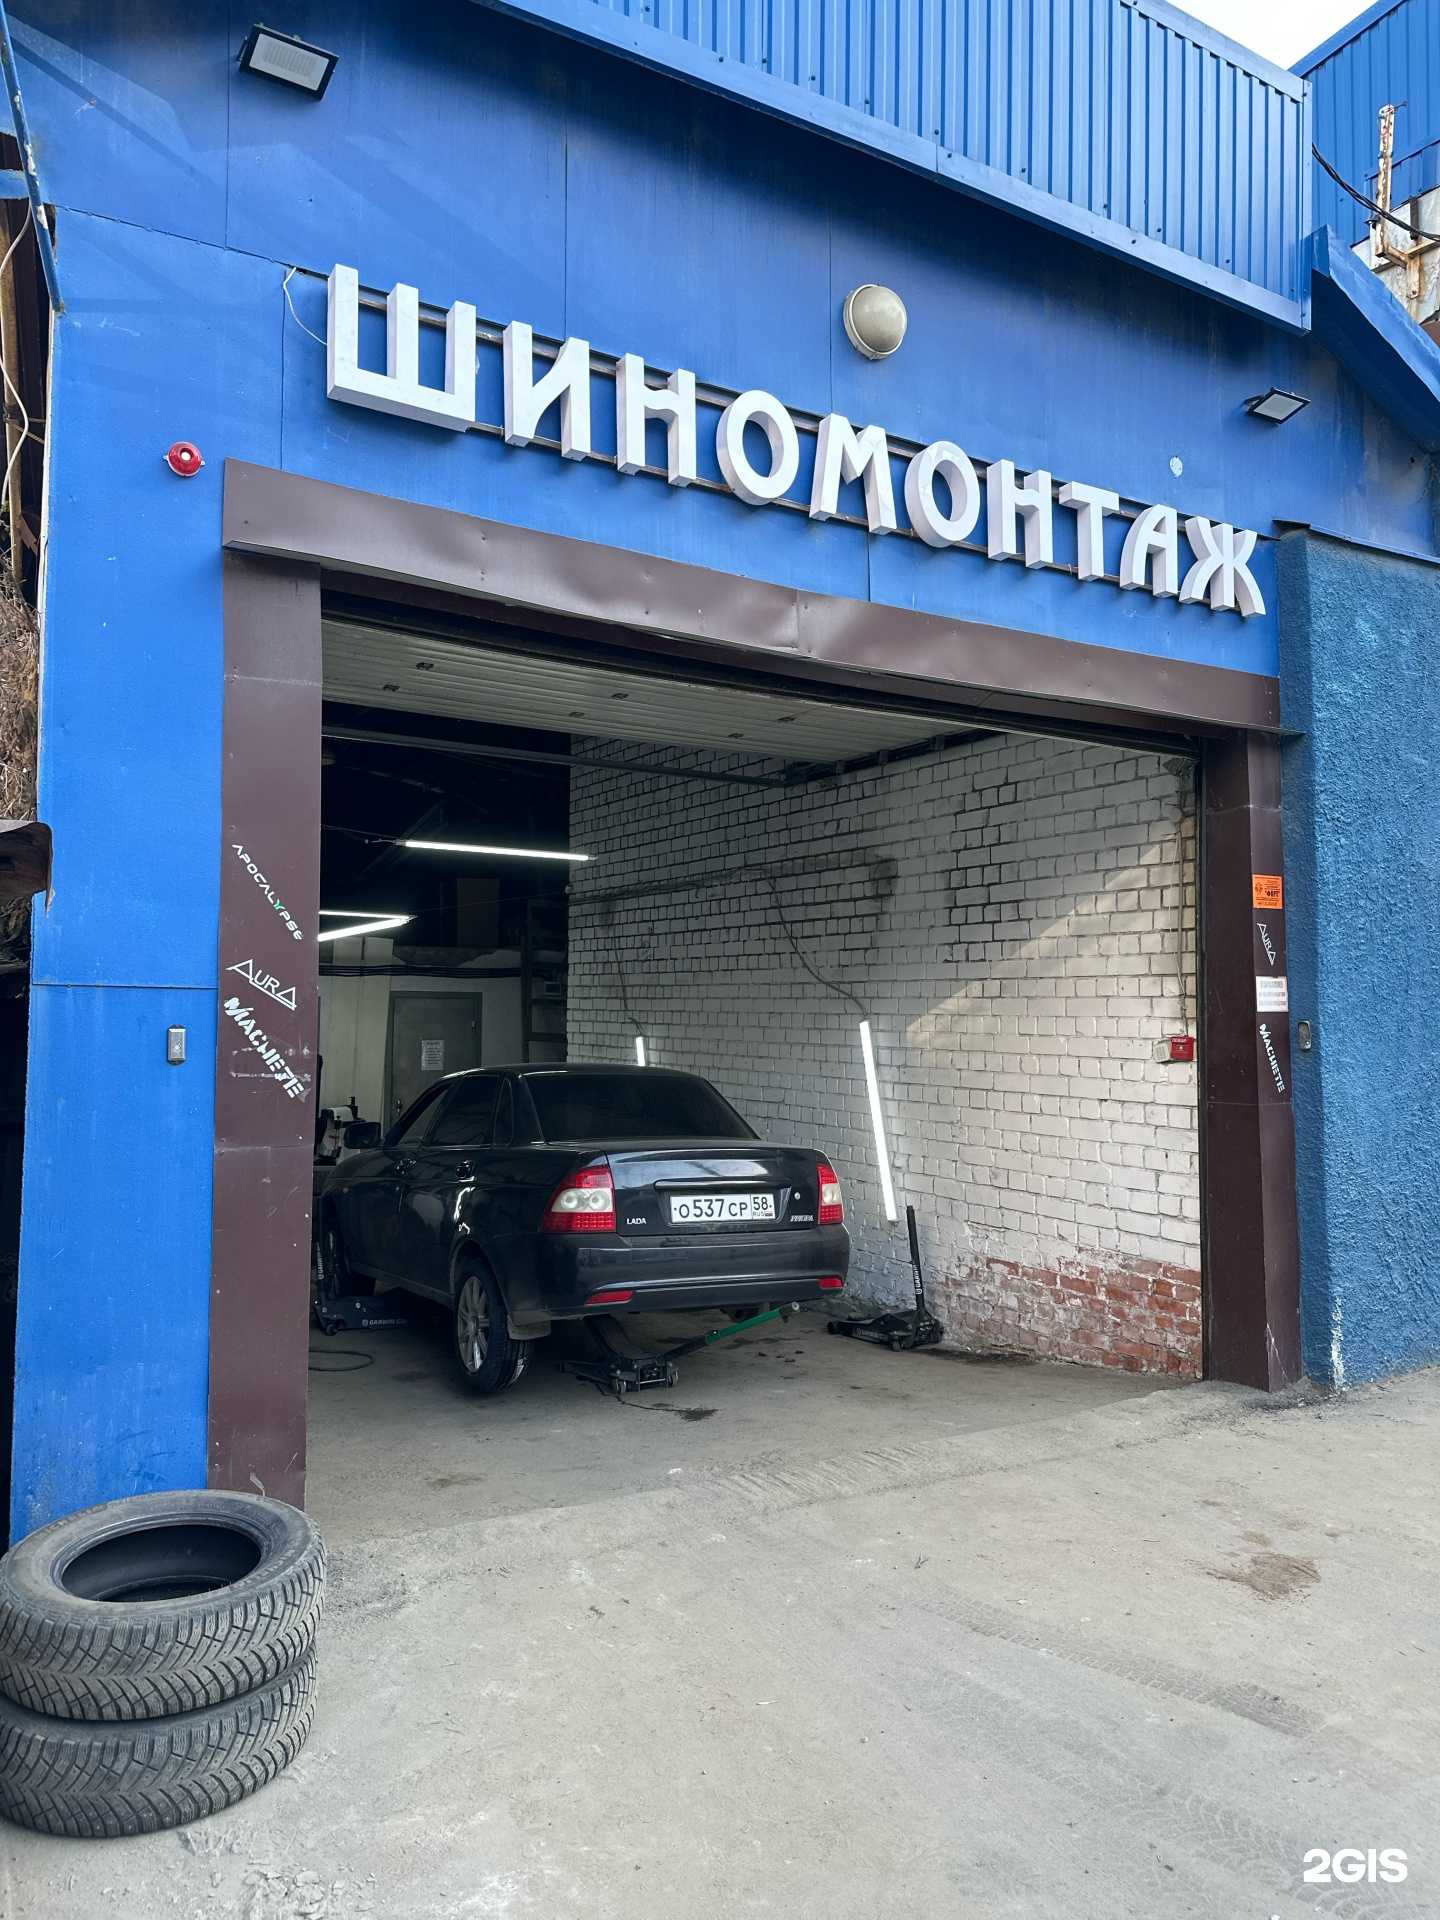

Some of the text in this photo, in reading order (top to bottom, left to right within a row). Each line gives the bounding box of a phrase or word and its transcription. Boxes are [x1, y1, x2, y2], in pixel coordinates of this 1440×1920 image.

[327, 263, 1266, 618] ШИНОМОНТАЖ
[232, 844, 303, 941] APOCALYPSE
[226, 959, 297, 1010] AURA
[224, 997, 304, 1098] MACHETE
[1259, 1024, 1285, 1093] MACHETE
[626, 1217, 647, 1225] LADA
